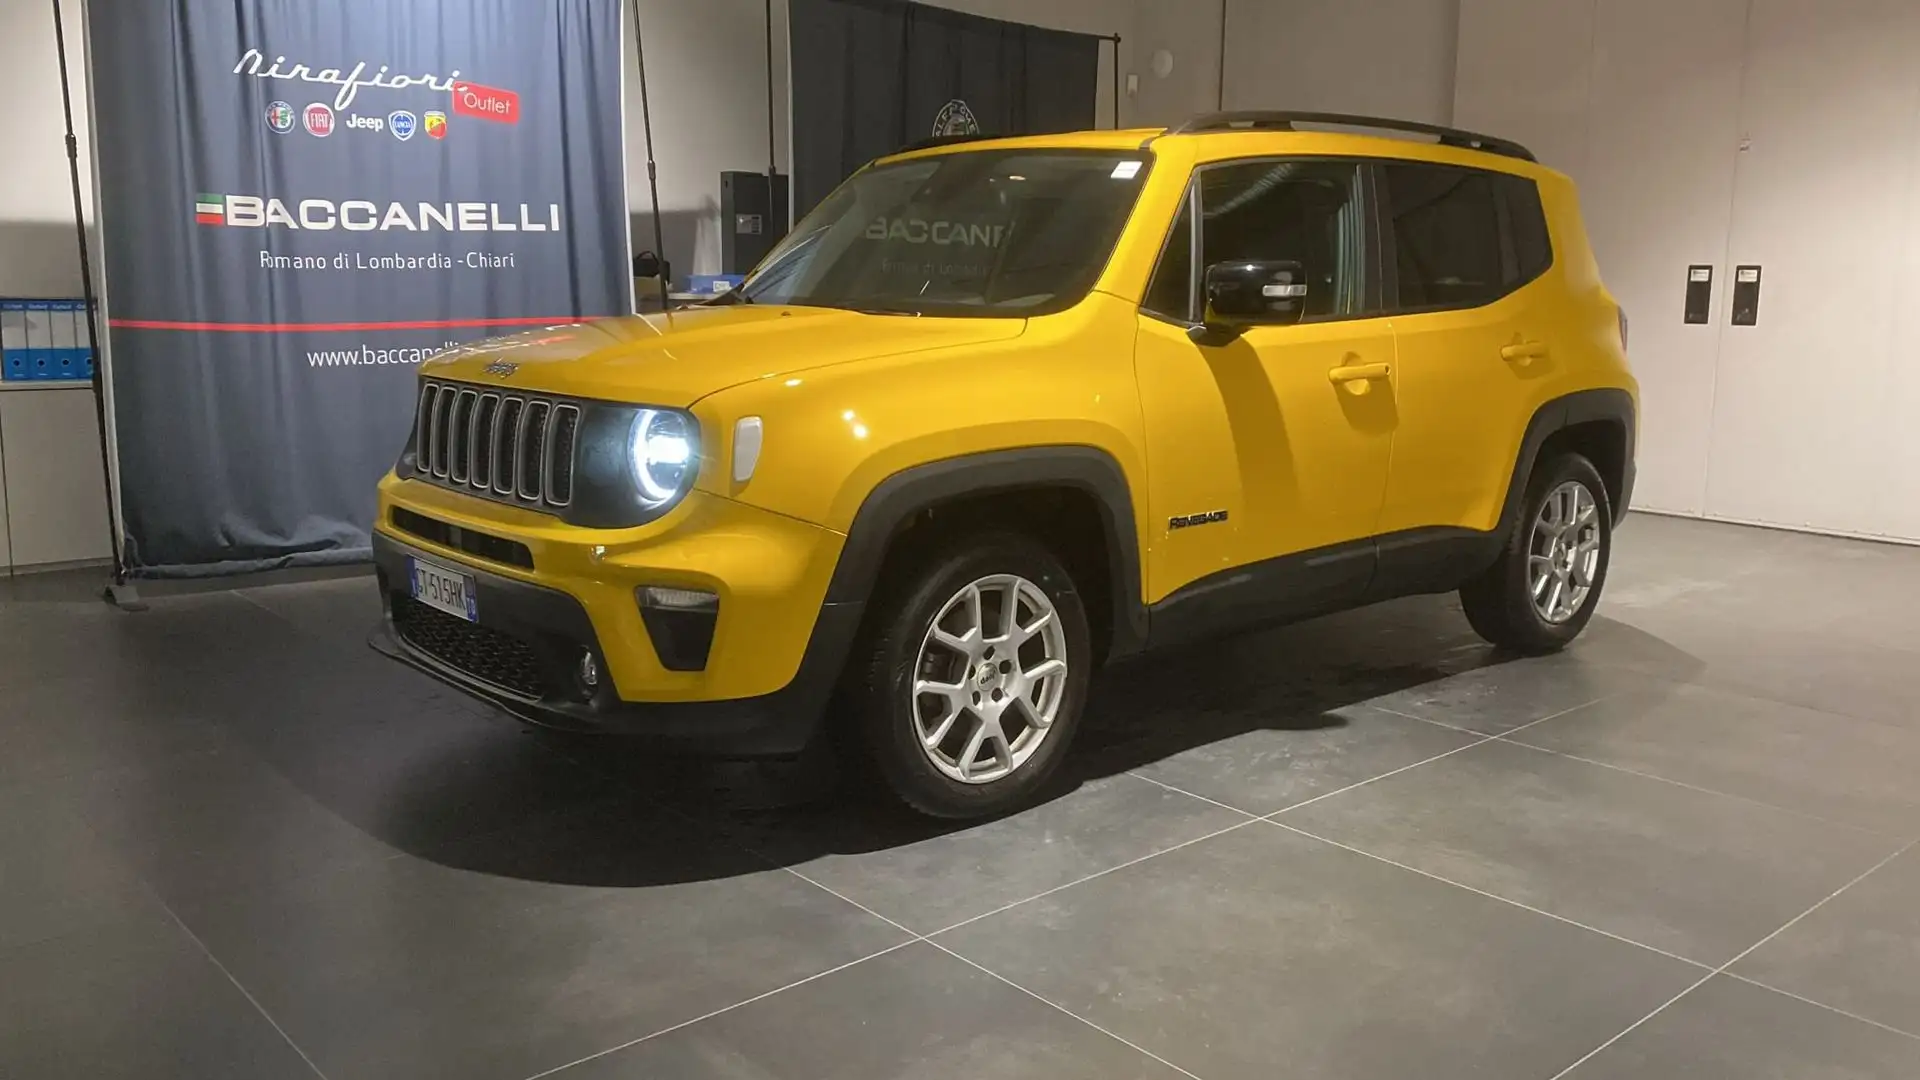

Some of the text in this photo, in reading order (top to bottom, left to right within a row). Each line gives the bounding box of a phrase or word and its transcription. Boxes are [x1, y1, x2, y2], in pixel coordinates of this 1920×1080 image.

[463, 92, 511, 114] Outlet
[310, 112, 329, 128] FIAT
[346, 113, 384, 132] Jeep
[225, 194, 560, 231] BACCANELLI
[333, 252, 350, 269] di
[356, 252, 452, 269] Lombardia
[306, 341, 459, 367] www.baccan
